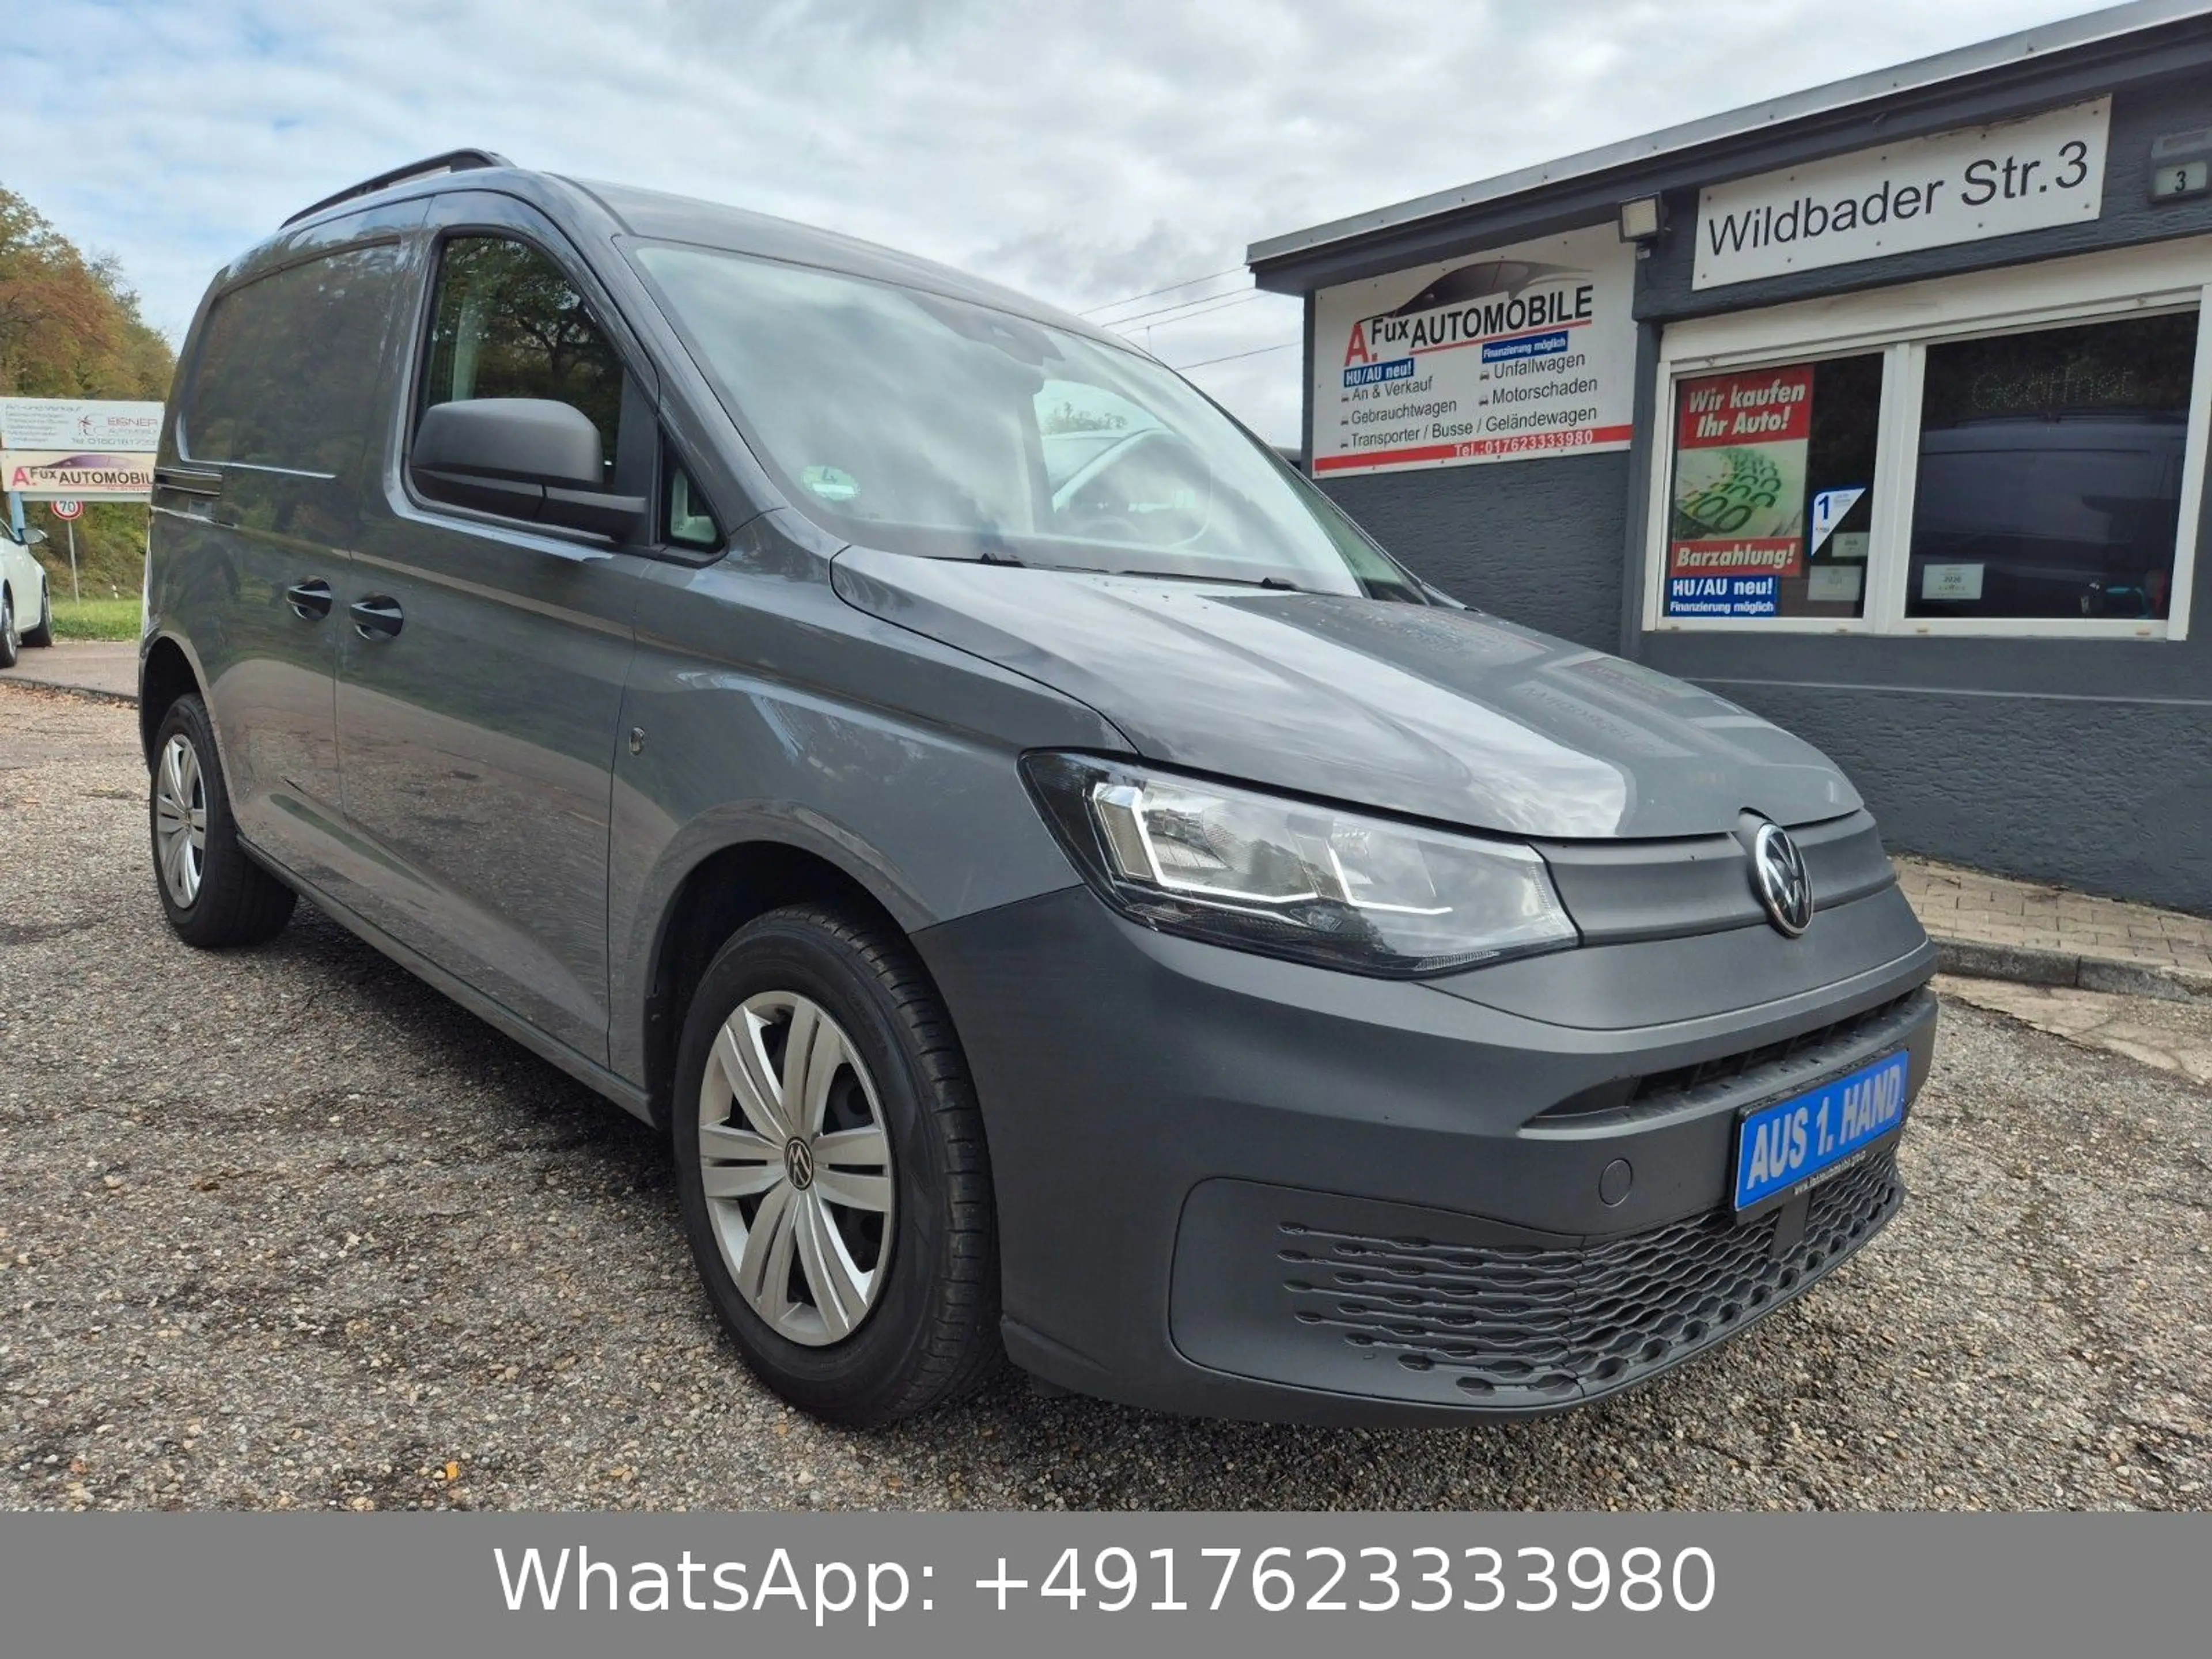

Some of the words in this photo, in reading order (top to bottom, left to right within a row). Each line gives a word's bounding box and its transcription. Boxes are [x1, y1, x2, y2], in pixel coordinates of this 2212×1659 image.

[2175, 171, 2187, 192] 3
[1709, 179, 1944, 256] Wildbader
[1344, 323, 1378, 367] A.
[1372, 317, 1410, 345] Fux
[1411, 285, 1593, 348] AUTOMOBILE
[1483, 343, 1532, 360] Finanzierung
[1534, 337, 1567, 354] möglich
[1345, 366, 1383, 386] HU/AU
[1385, 362, 1414, 380] neu!
[1494, 352, 1585, 380] Unfallwagen
[1352, 388, 1369, 401] An
[1373, 385, 1381, 399] &
[1385, 376, 1433, 396] Verkauf
[1492, 377, 1598, 406] Motorschaden
[1689, 387, 1725, 414] Wir
[1730, 379, 1806, 409] kaufen
[1351, 399, 1457, 425] Gebrauchtwagen
[1697, 415, 1728, 438] Ihr
[1732, 407, 1791, 435] Auto!
[1352, 427, 1421, 448] Transporter
[1423, 424, 1429, 440] /
[1433, 422, 1474, 438] Busse
[1476, 418, 1482, 434] /
[1486, 406, 1597, 433] Geländewagen
[30, 469, 56, 479] Fux
[59, 500, 75, 512] 70
[1818, 495, 1830, 520] 1
[1677, 543, 1797, 569] Barzahlung!
[1673, 578, 1728, 596] HU/AU
[1734, 577, 1773, 596] neu!
[1671, 601, 1731, 615] Finanzierung
[1734, 601, 1774, 614] möglich
[1746, 1107, 1809, 1190] AUS
[1816, 1096, 1835, 1156] 1.
[1840, 1064, 1901, 1146] HAND
